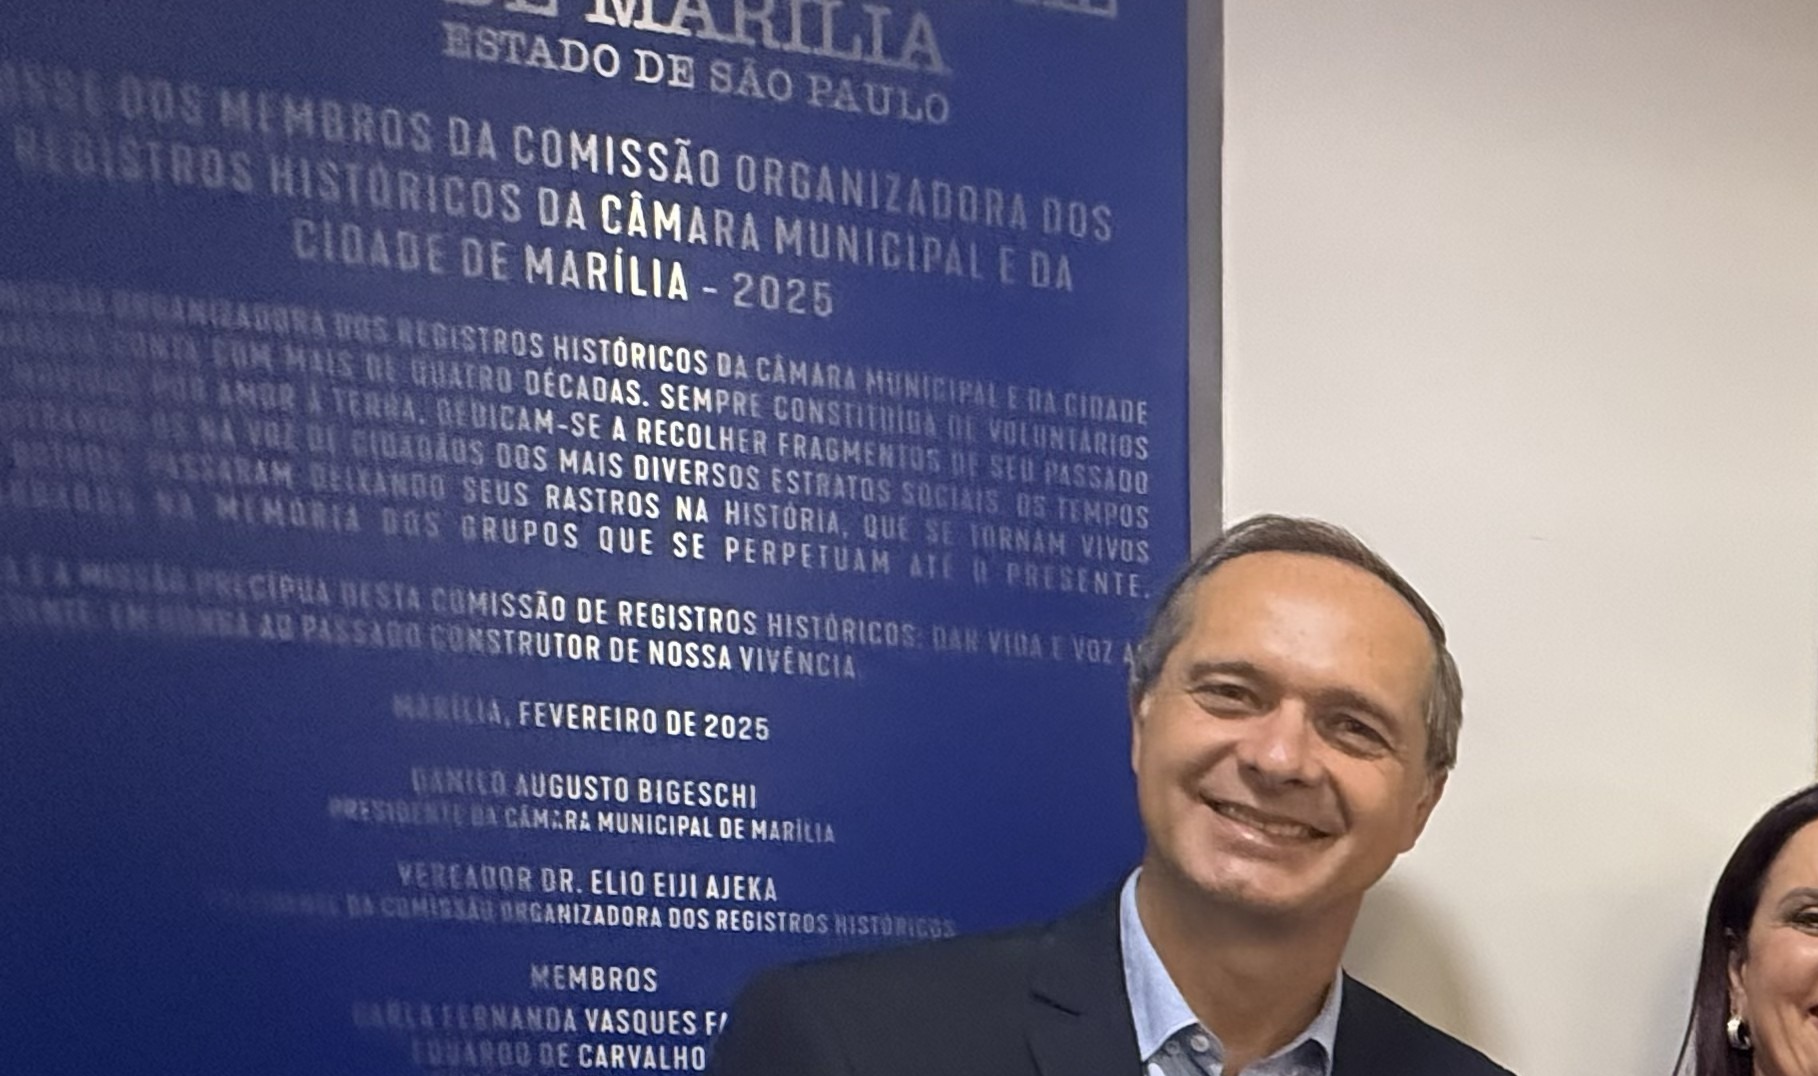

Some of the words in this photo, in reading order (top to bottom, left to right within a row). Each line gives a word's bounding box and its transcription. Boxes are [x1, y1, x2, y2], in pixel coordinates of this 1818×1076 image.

[443, 20, 620, 78] ESTADO
[634, 48, 694, 89] DE
[710, 57, 793, 102] SÃO
[807, 74, 949, 124] PAULO
[449, 117, 496, 161] DA
[514, 125, 719, 188] COMISSÃO
[737, 154, 1027, 231] ORGANIZADORA
[1044, 197, 1112, 242] DOS
[272, 153, 521, 223] HISTÓRICOS
[538, 186, 586, 230] DA
[602, 190, 759, 252] CÂMARA
[775, 215, 984, 280] MUNICIPAL
[1031, 250, 1072, 291] DA
[293, 216, 444, 274] CIDADE
[525, 244, 688, 301] MARÍLIA
[733, 272, 833, 317] 2025
[554, 335, 707, 376] HISTÓRICOS
[717, 352, 747, 378] DA
[525, 367, 650, 408] DÉCADAS.
[660, 383, 763, 418] SEMPRE
[637, 418, 767, 455] RECOLHER
[496, 442, 547, 472] DOS
[560, 448, 623, 479] MAIS
[634, 454, 760, 491] DIVERSOS
[772, 468, 891, 504] ESTRATOS
[546, 484, 660, 519] RASTROS
[677, 495, 709, 524] NA
[461, 514, 578, 549] GRUPOS
[599, 526, 653, 556] QUE
[673, 532, 705, 560] SE
[725, 536, 890, 574] PERPETUAM
[577, 597, 608, 626] DE
[618, 600, 757, 636] REGISTROS
[650, 639, 731, 671] NOSSA
[739, 645, 856, 679] VIVÊNCIA
[519, 700, 657, 735] FEVEREIRO
[666, 710, 697, 737] DE
[704, 713, 769, 741] 2025
[515, 771, 629, 803] AUGUSTO
[638, 778, 757, 810] BIGESCHI
[598, 811, 714, 839] MUNICIPAL
[752, 818, 836, 844] MARÍLIA
[541, 867, 582, 895] DR.
[591, 869, 645, 896] ELIO
[653, 872, 697, 899] EIJI
[706, 874, 777, 902] AJEKA
[502, 902, 662, 928] ORGANIZADORA
[717, 909, 828, 934] REGISTROS
[530, 964, 658, 993] MEMBROS
[584, 1008, 697, 1037] VASQUES
[579, 1044, 706, 1071] CARVALHO
